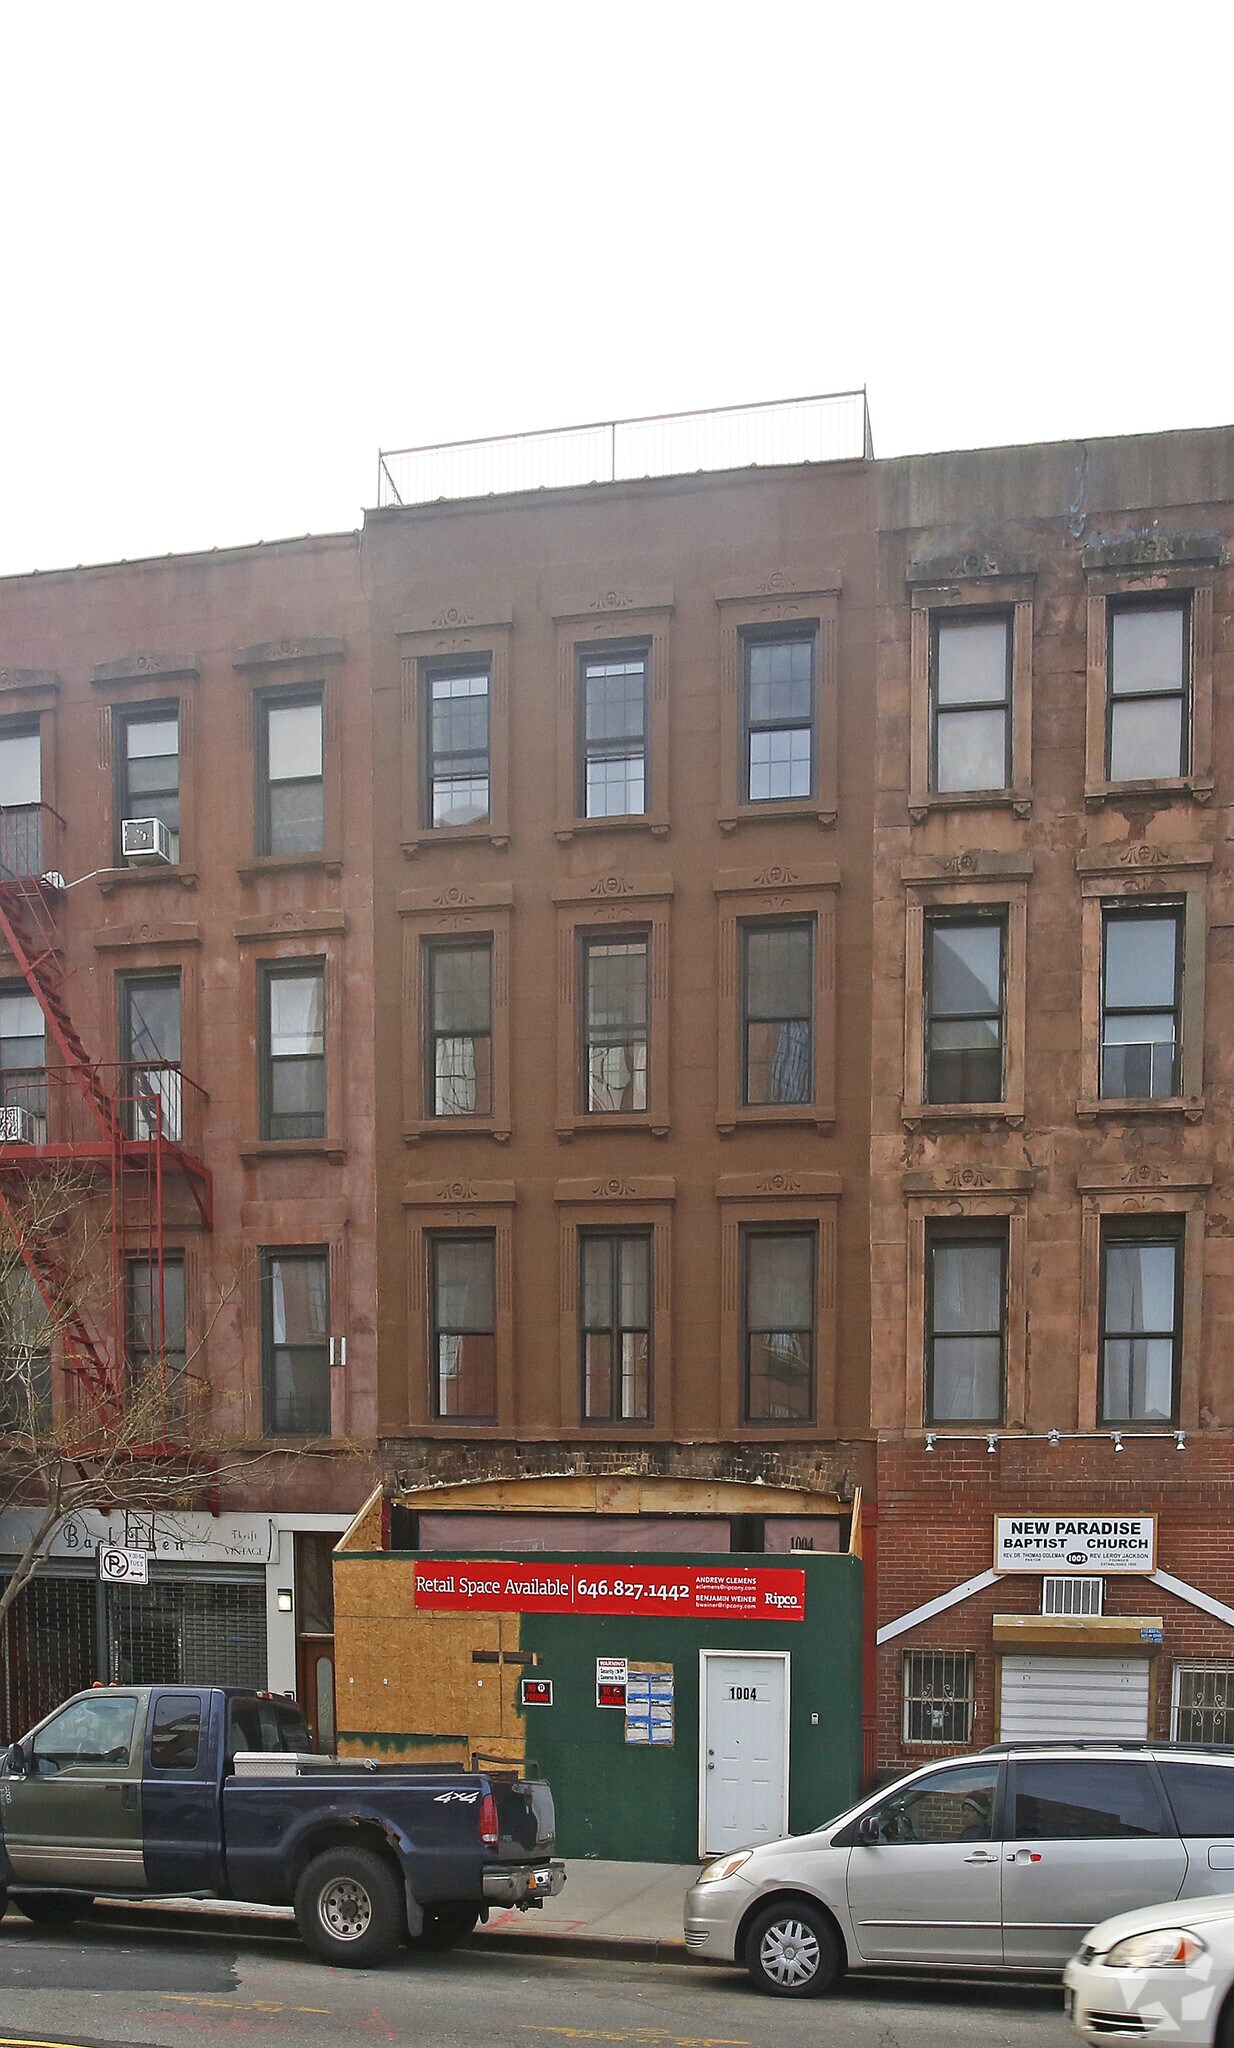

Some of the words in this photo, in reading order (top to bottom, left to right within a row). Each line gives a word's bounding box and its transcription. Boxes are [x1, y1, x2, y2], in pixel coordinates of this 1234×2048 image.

[1011, 1522, 1050, 1535] NEW
[1055, 1522, 1141, 1535] PARADISE
[1003, 1538, 1068, 1549] BAPTIST
[1086, 1539, 1149, 1549] CHURCH
[224, 1547, 263, 1556] VINTAGE
[1068, 1554, 1087, 1563] 1002
[416, 1576, 456, 1593] Retail
[459, 1577, 501, 1597] Space
[504, 1578, 569, 1597] Available
[725, 1577, 757, 1585] CLEMENS
[577, 1578, 690, 1601] 646.827.1442
[695, 1594, 730, 1602] BENJAMIN
[730, 1595, 757, 1603] WEINER
[764, 1592, 798, 1609] Ripco
[729, 1686, 757, 1701] 1004
[433, 1791, 480, 1804] 4x4
